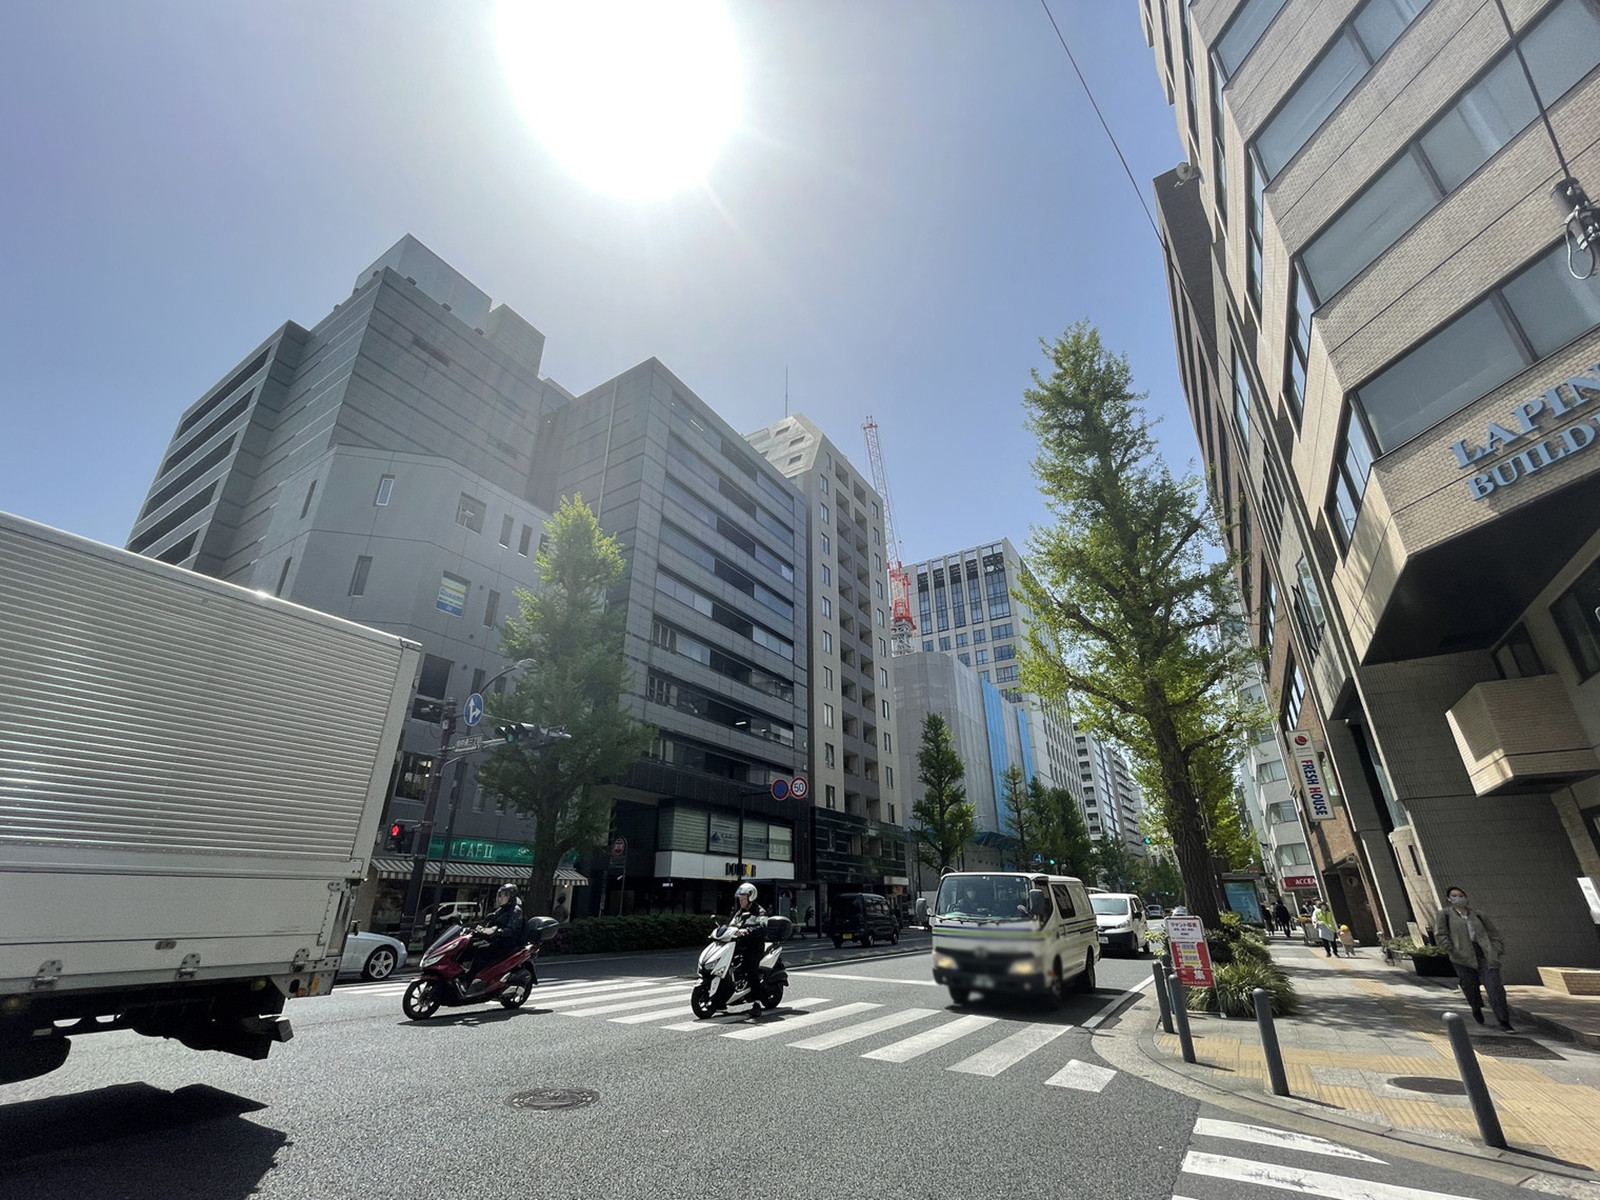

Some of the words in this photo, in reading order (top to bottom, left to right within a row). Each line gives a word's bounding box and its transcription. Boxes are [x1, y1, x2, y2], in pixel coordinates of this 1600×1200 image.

[1466, 413, 1600, 501] BUILD
[1301, 759, 1319, 785] FRESH
[793, 782, 805, 793] 50
[1308, 786, 1328, 816] HOUSE
[725, 862, 757, 878] DOTOR
